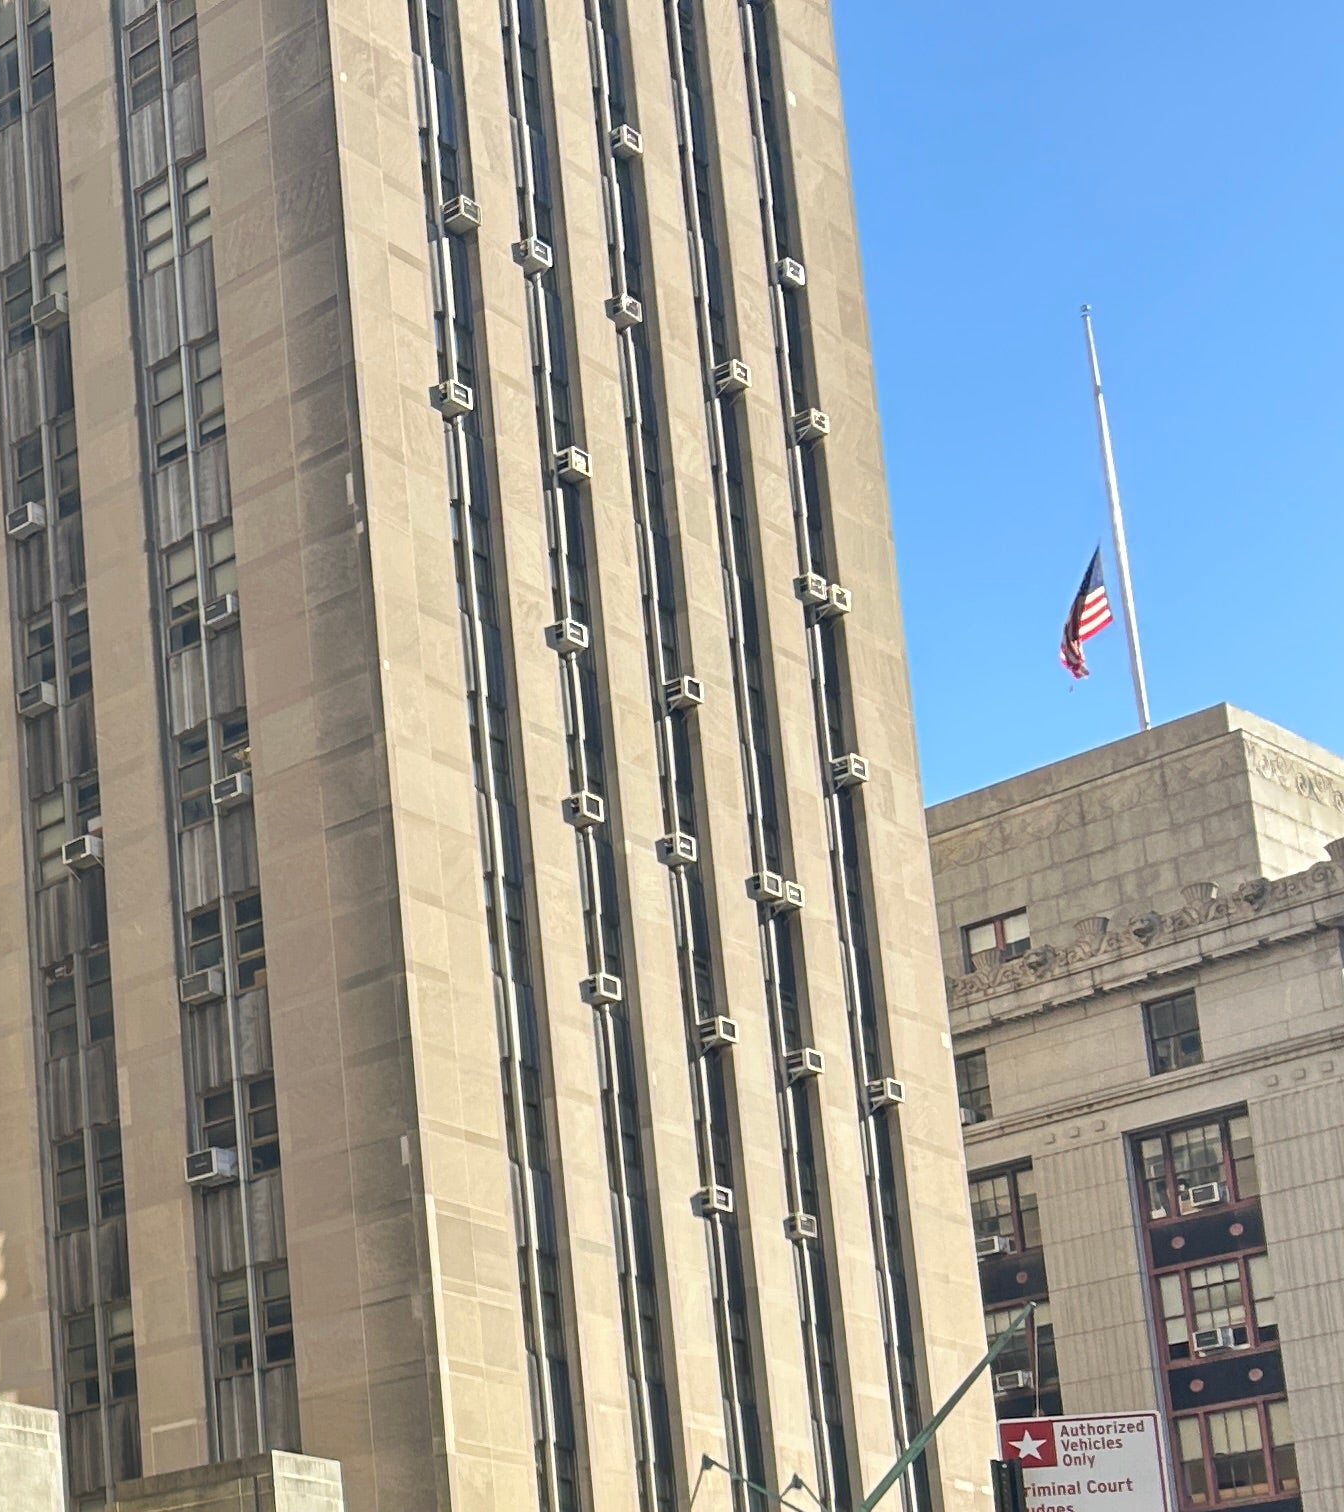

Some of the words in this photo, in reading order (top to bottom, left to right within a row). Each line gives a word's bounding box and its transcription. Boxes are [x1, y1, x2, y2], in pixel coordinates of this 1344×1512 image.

[1060, 1420, 1145, 1437] Authorized
[1060, 1437, 1123, 1452] Vehicles
[1062, 1453, 1096, 1468] Only
[1024, 1481, 1081, 1497] riminal
[1086, 1478, 1134, 1493] Court
